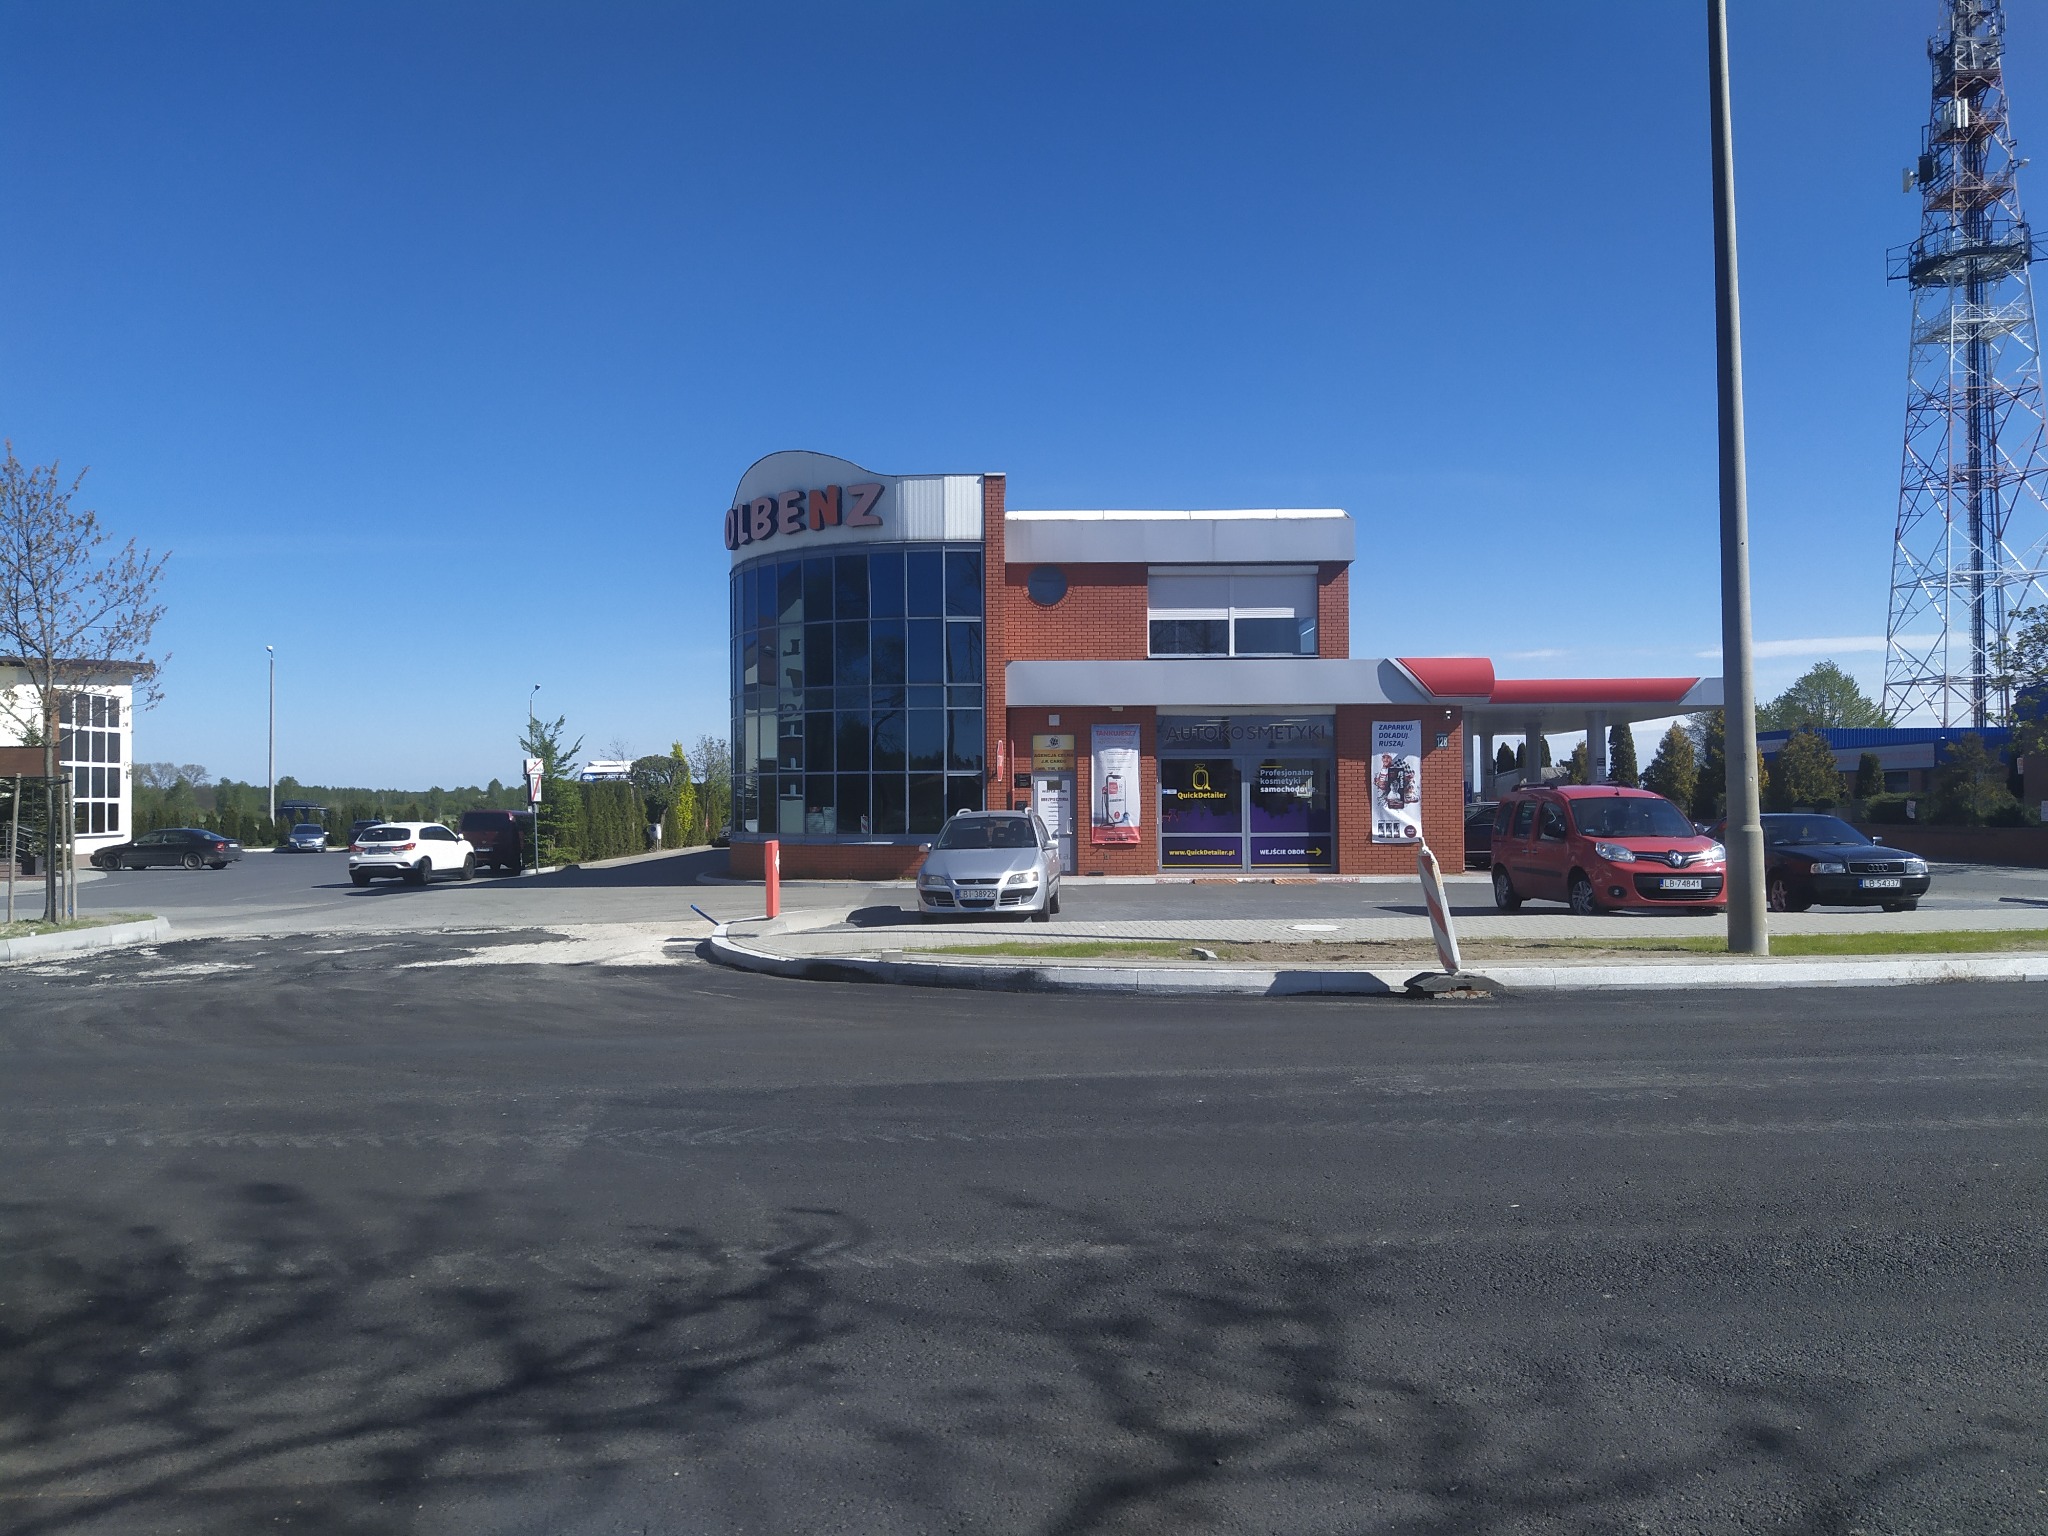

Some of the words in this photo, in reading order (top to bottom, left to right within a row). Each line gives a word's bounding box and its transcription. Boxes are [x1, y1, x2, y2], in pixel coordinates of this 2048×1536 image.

[1165, 725, 1325, 741] AUTOKOSMETYKI
[1437, 736, 1448, 747] 128
[1260, 769, 1314, 777] Profesjonalne
[1260, 777, 1301, 785] kosmetyki
[1177, 791, 1227, 800] QuickDetailer
[1169, 849, 1235, 857] www.QuickDetailer.pl
